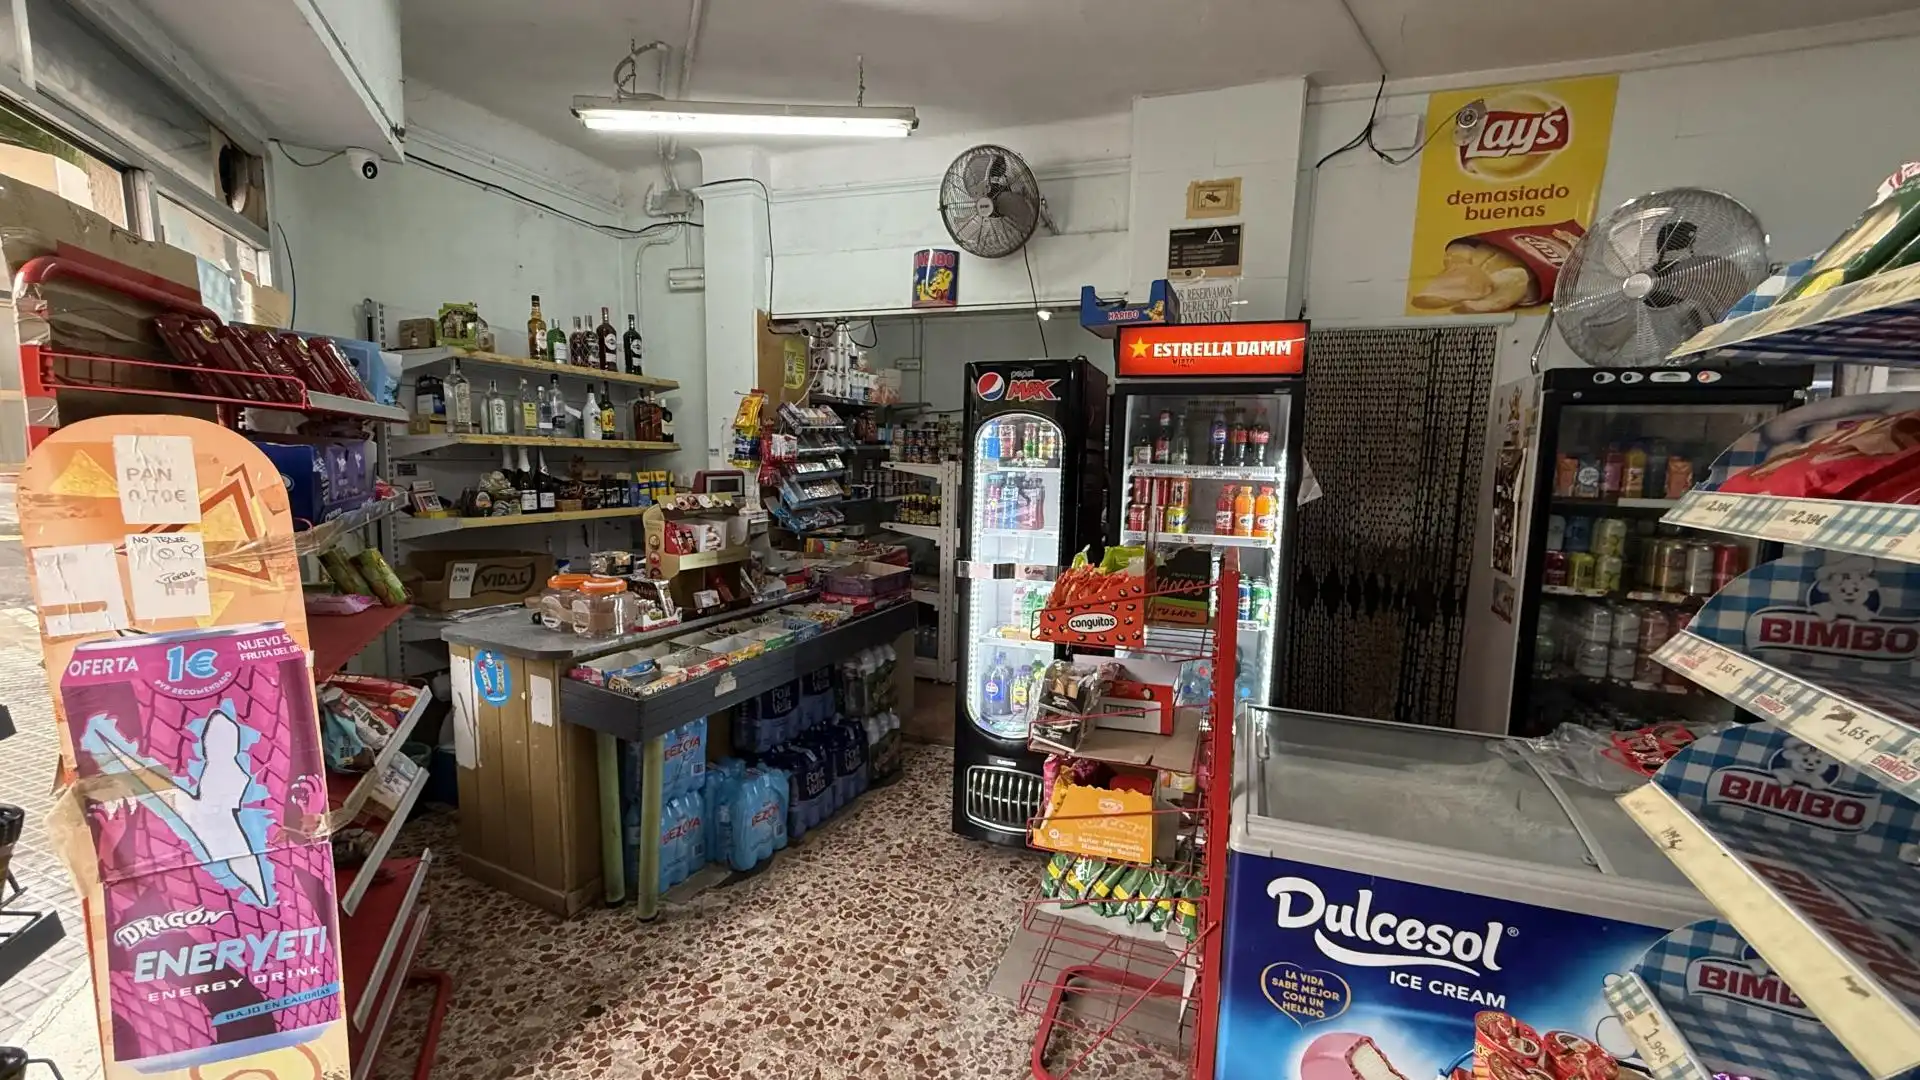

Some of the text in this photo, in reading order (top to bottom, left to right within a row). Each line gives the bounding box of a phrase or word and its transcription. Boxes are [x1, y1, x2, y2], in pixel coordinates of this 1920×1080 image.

[1447, 184, 1569, 205] demasiado
[1465, 204, 1545, 220] buenas
[1188, 285, 1232, 300] RESERVAMOS
[1183, 300, 1218, 312] DERECHO
[1107, 310, 1139, 321] HARIBO
[1180, 310, 1232, 323] DMISION
[1153, 340, 1292, 357] ESTRELLA DAMM
[1010, 369, 1034, 379] pepsi
[1005, 379, 1061, 401] MAX
[126, 468, 172, 481] PAN
[132, 536, 149, 544] NO
[481, 571, 526, 588] VIDAL
[1071, 616, 1115, 630] conguitos
[1759, 617, 1920, 652] BIMBO
[236, 636, 281, 652] NUEVO
[240, 650, 273, 662] FRUTA
[273, 648, 290, 657] DEL
[68, 656, 139, 677] OFERTA
[166, 646, 218, 682] 1€
[154, 671, 233, 696] PVP RECOMENDADO
[1871, 755, 1917, 781] BIMBO
[1719, 773, 1866, 826] BIMBO
[1267, 877, 1503, 971] Dulcesol
[134, 925, 327, 983] ENERYETI
[147, 966, 321, 1003] ENERGY DRINK
[1285, 970, 1324, 986] LA VIDA
[1272, 978, 1340, 1002] SABE MEJOR
[1389, 971, 1506, 1009] ICE CREAM
[1698, 965, 1807, 1009] BIM
[225, 987, 331, 1021] BAJO EN CALORÍAS
[1283, 991, 1324, 1008] CON UN
[1283, 1001, 1325, 1018] HELADO
